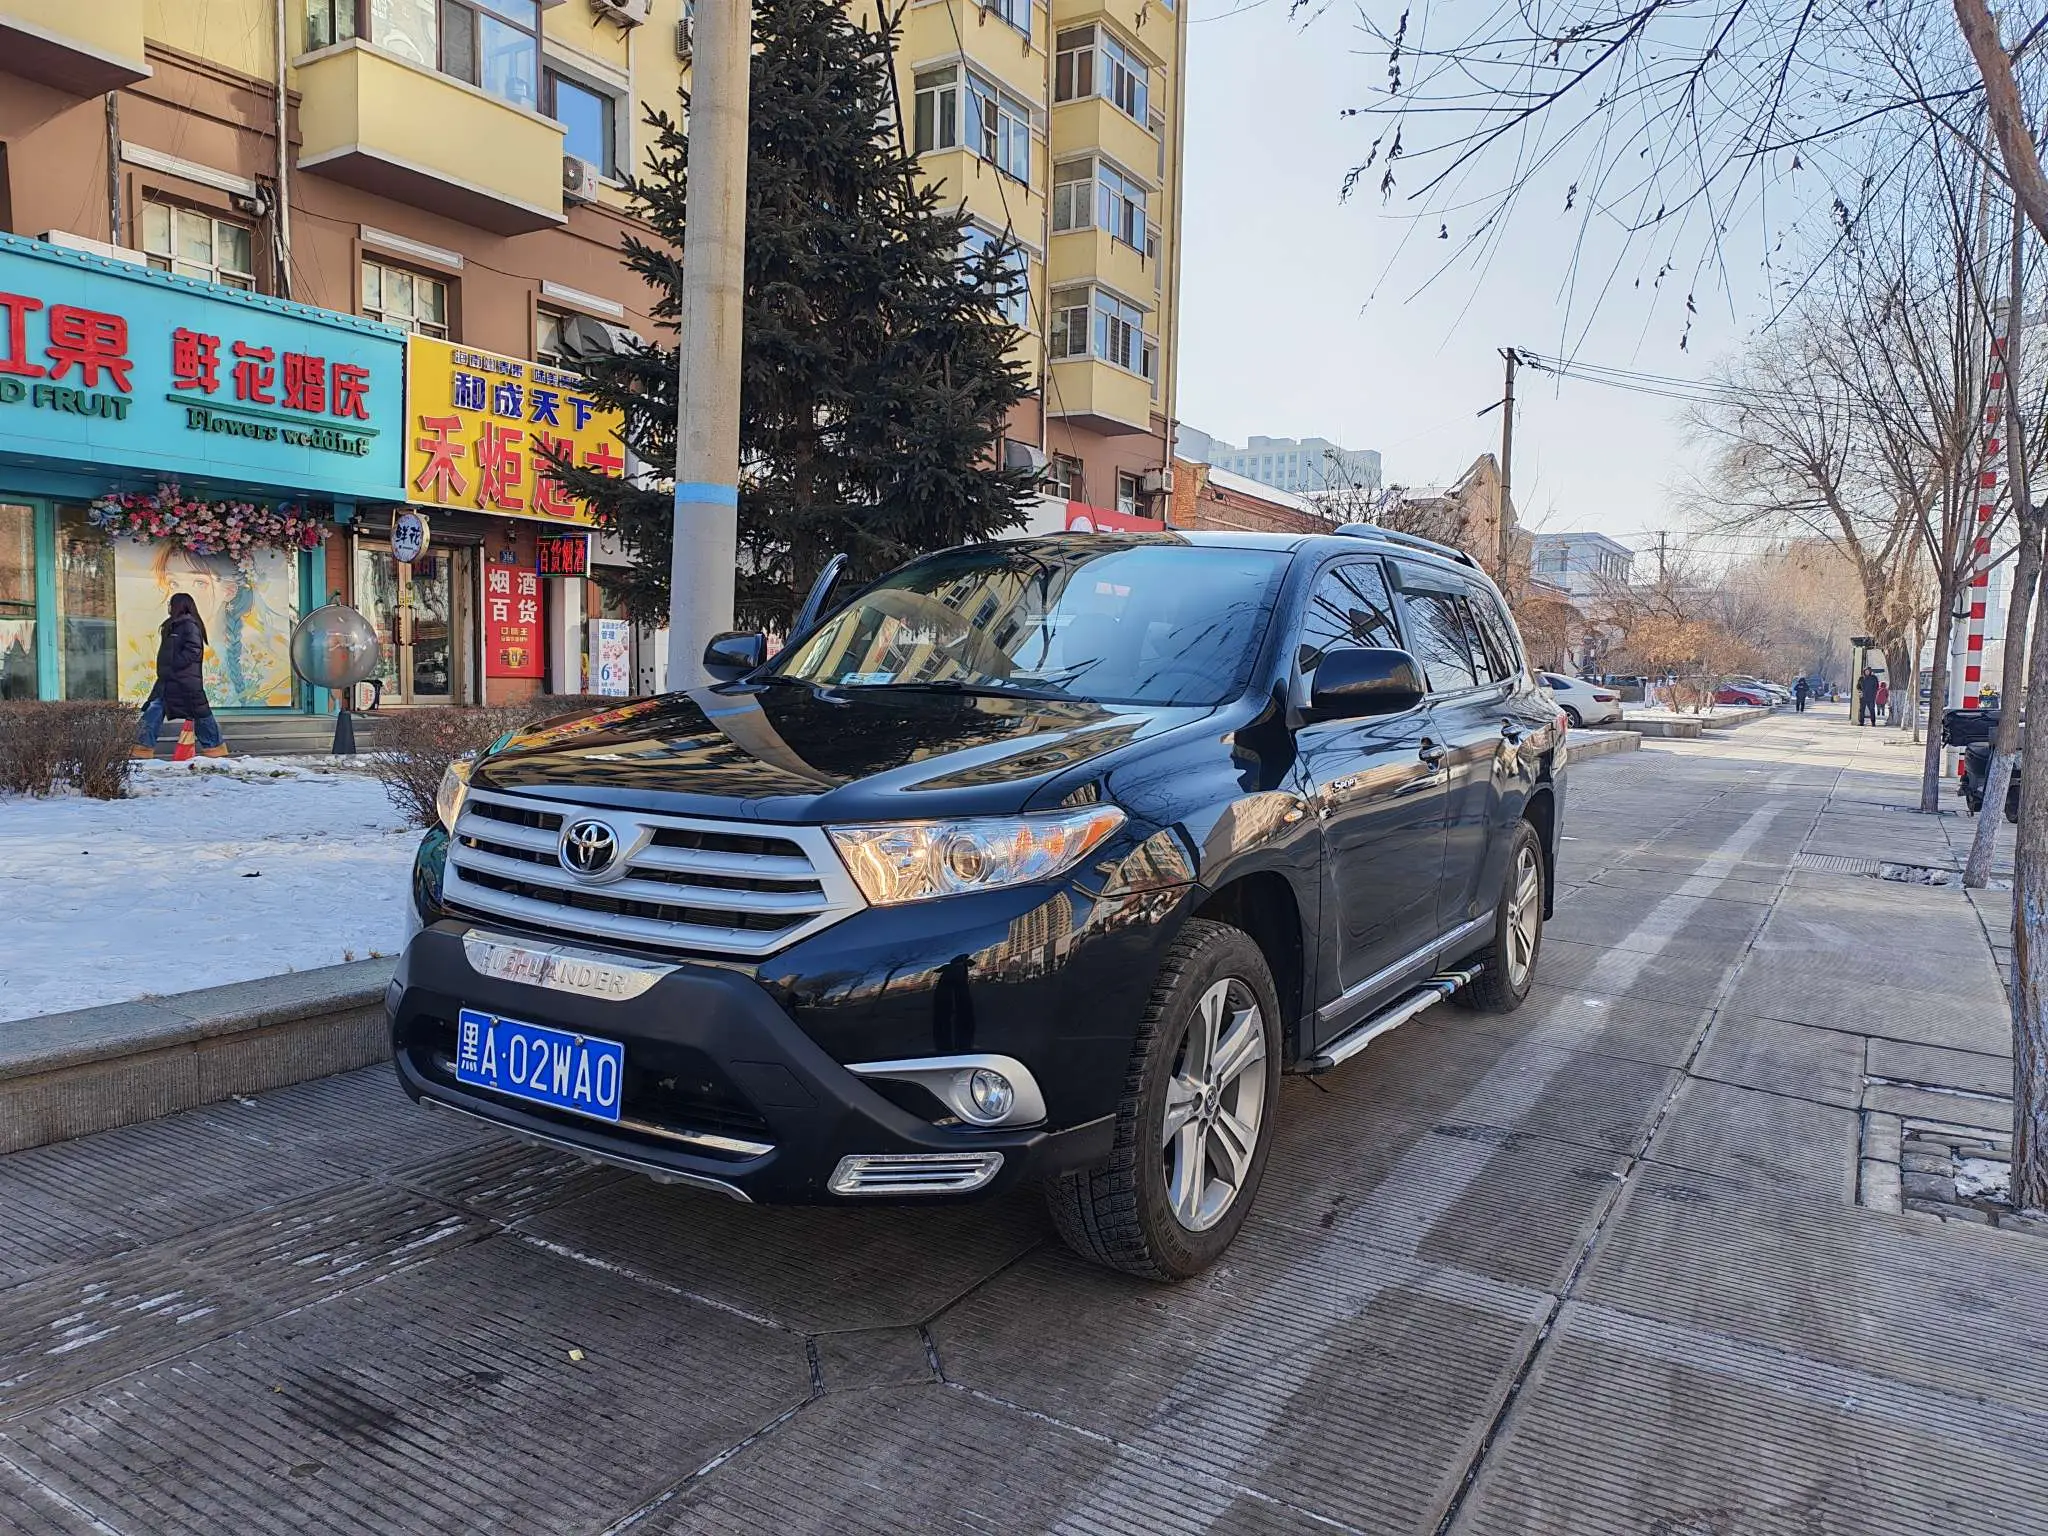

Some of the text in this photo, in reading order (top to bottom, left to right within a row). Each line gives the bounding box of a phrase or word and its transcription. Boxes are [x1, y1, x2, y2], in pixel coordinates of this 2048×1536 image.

[173, 327, 370, 419] 鲜花婚庆
[33, 384, 133, 420] FRUIT
[453, 371, 597, 431] 和成天下
[186, 407, 371, 457] Flowers wedding
[396, 524, 420, 545] 鲜花
[538, 538, 586, 573] 百货烟酒
[489, 569, 536, 596] 烟酒
[489, 598, 538, 624] 百货
[481, 946, 626, 994] HIGHLANDER
